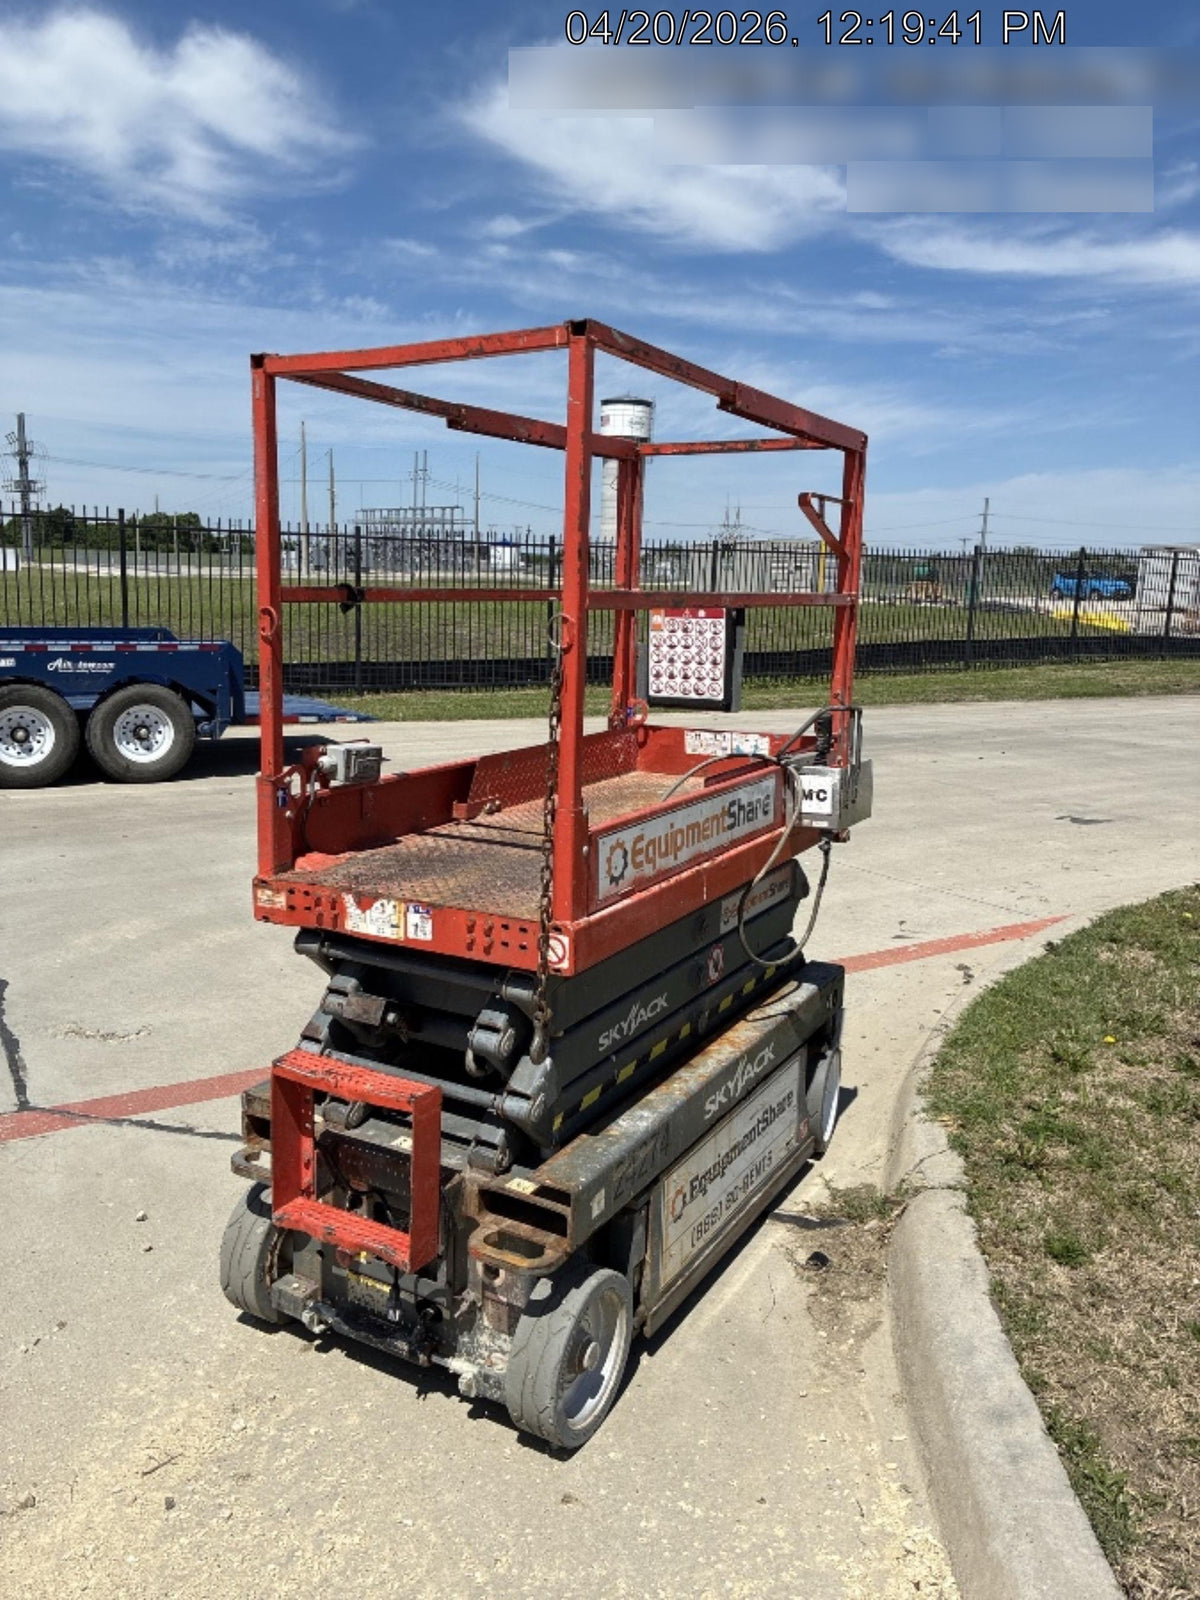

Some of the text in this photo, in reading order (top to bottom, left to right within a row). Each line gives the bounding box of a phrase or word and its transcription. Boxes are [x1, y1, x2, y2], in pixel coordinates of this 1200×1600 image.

[630, 793, 771, 870] EquipmentShare
[598, 992, 669, 1052] SKYJACK
[704, 1042, 775, 1120] SKYJACK
[689, 1090, 794, 1202] EquipmentShare
